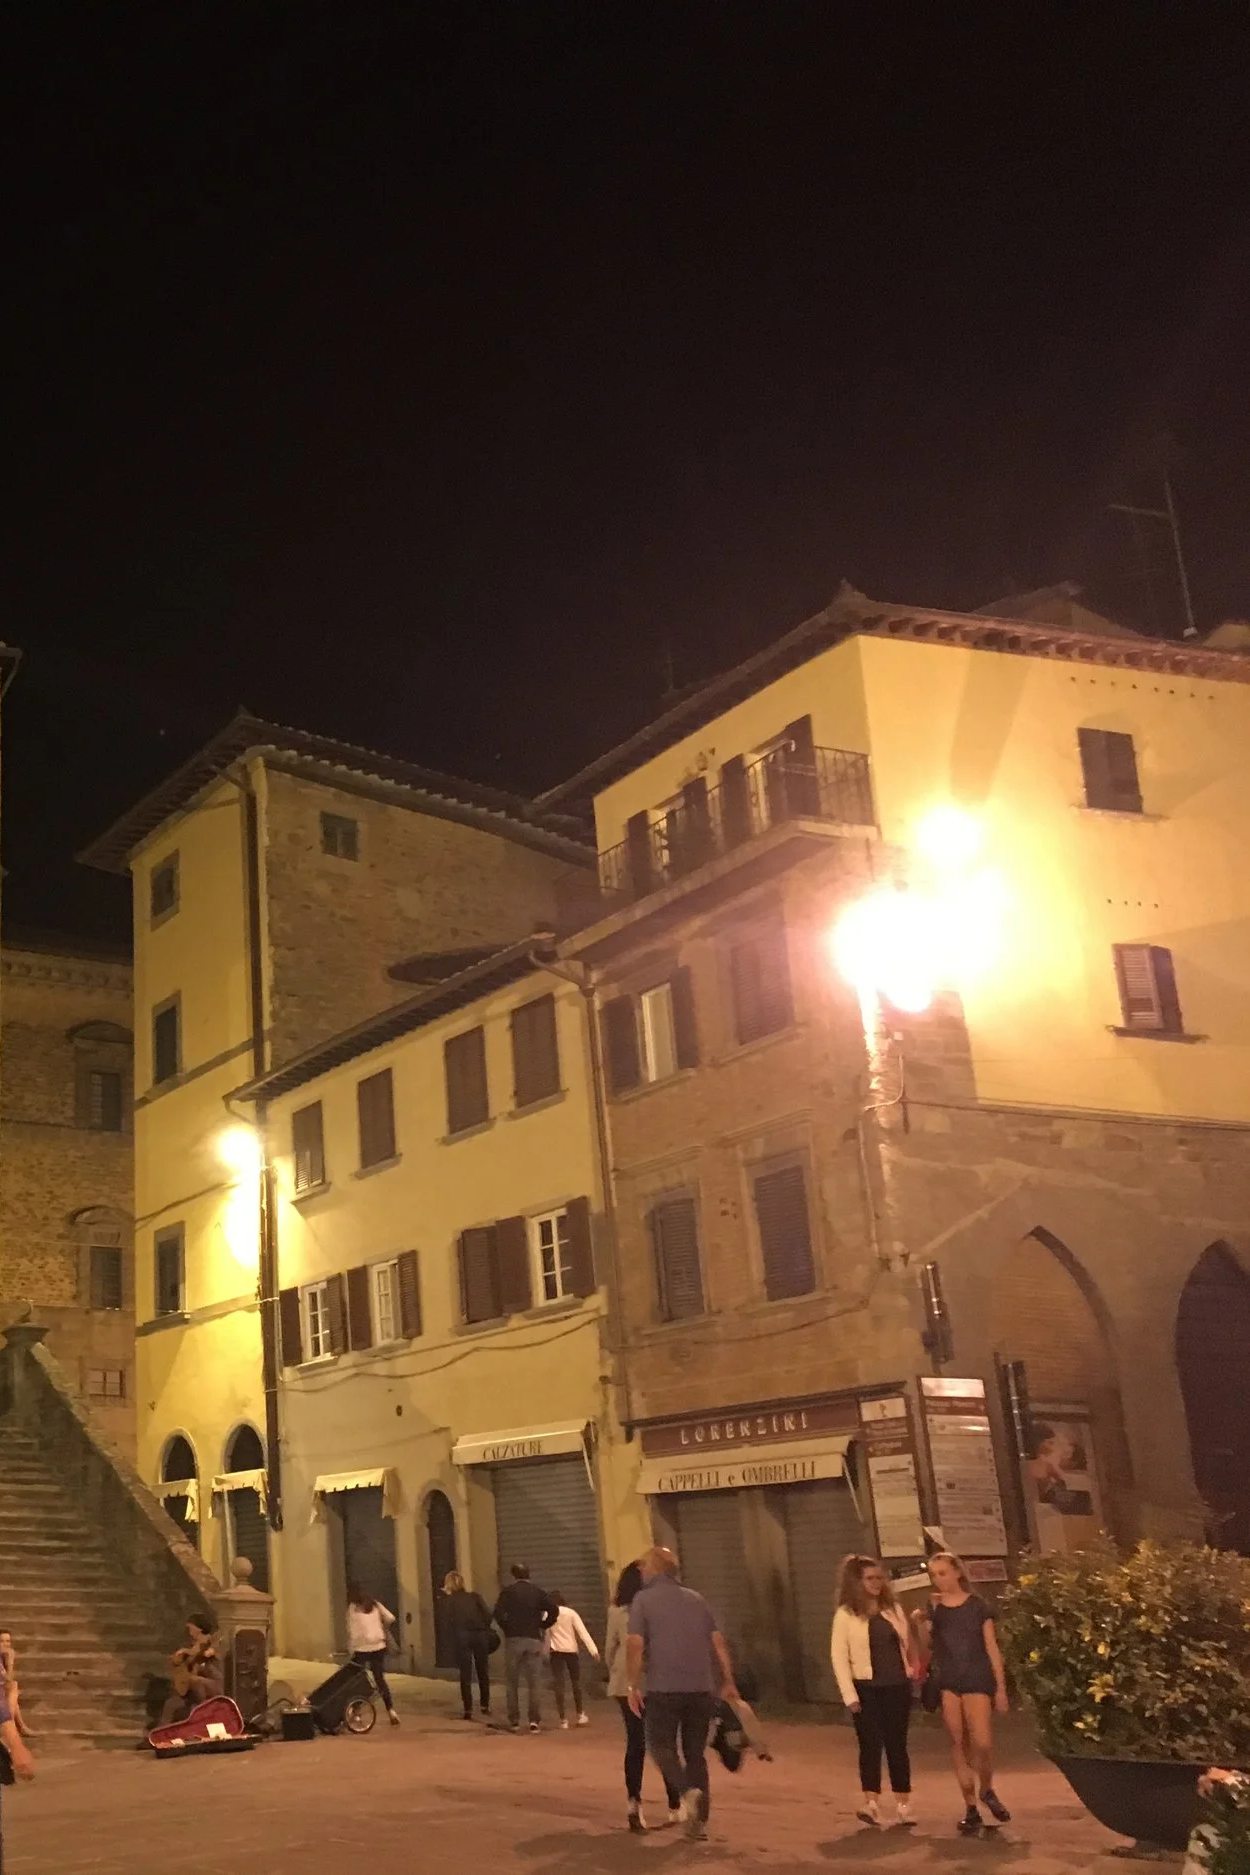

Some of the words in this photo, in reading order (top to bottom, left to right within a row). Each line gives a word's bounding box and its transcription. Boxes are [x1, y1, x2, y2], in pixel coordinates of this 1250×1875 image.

[680, 1412, 808, 1445] LORENZINI
[482, 1441, 543, 1460] CALZATURE
[658, 1471, 720, 1492] CAPPELLI
[727, 1475, 737, 1486] e
[742, 1461, 816, 1484] OMBRELLI
